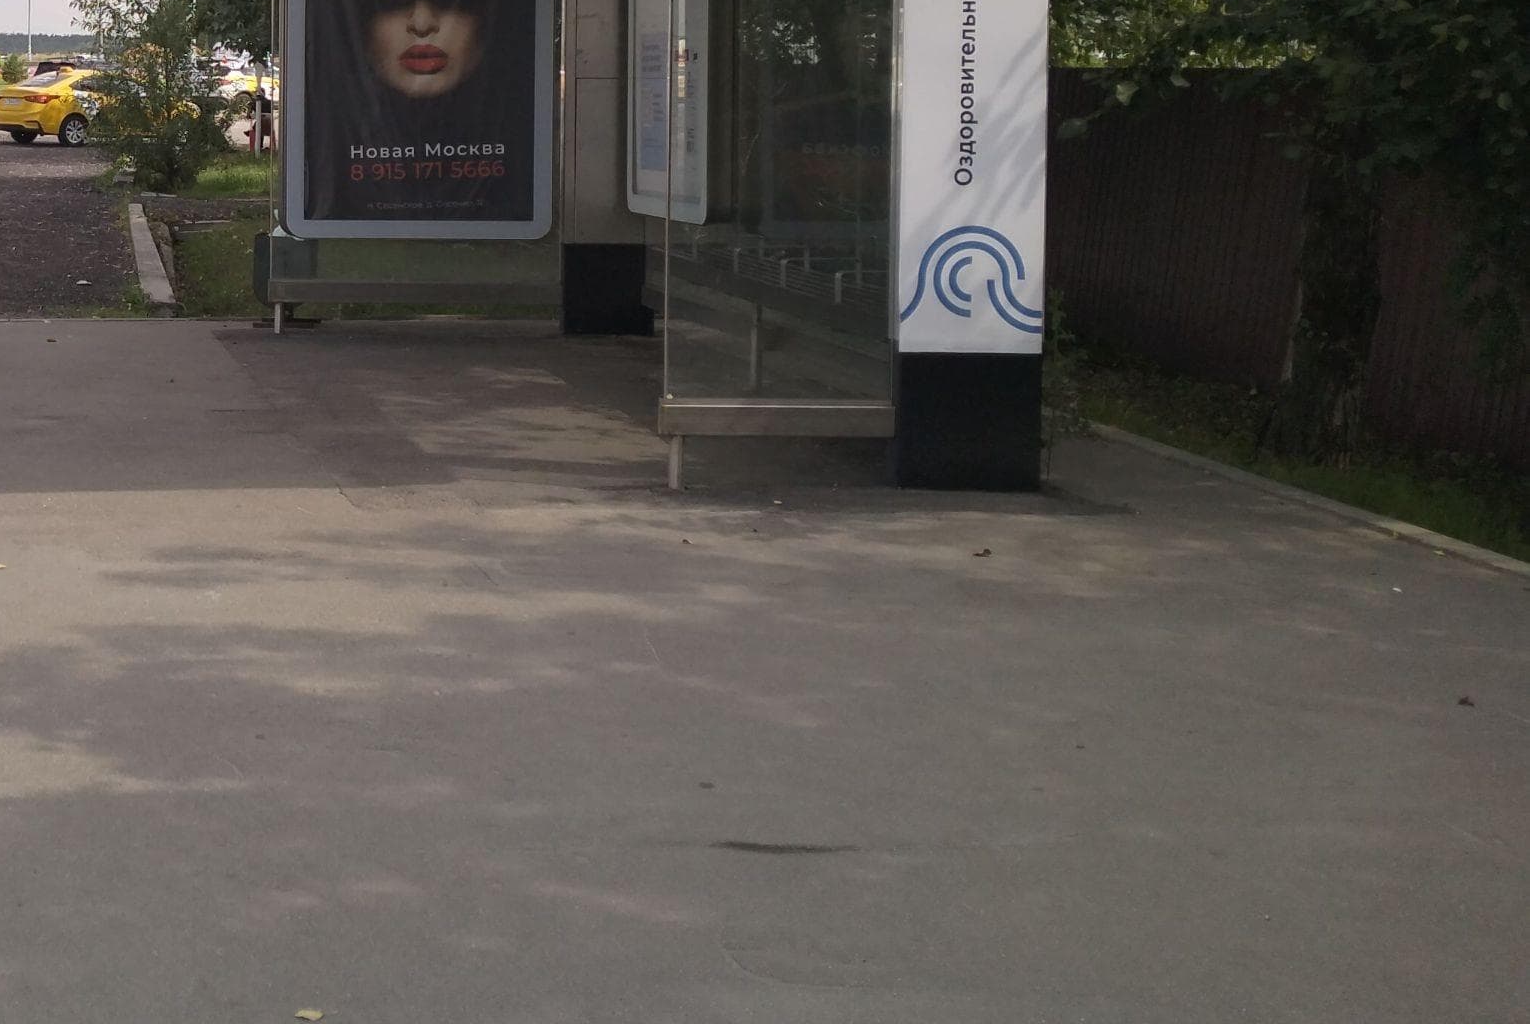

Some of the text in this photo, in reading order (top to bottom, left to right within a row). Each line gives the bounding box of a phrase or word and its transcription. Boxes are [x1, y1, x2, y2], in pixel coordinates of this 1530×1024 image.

[350, 142, 506, 160] Новая Москва
[350, 160, 505, 181] 8 915 171 5666
